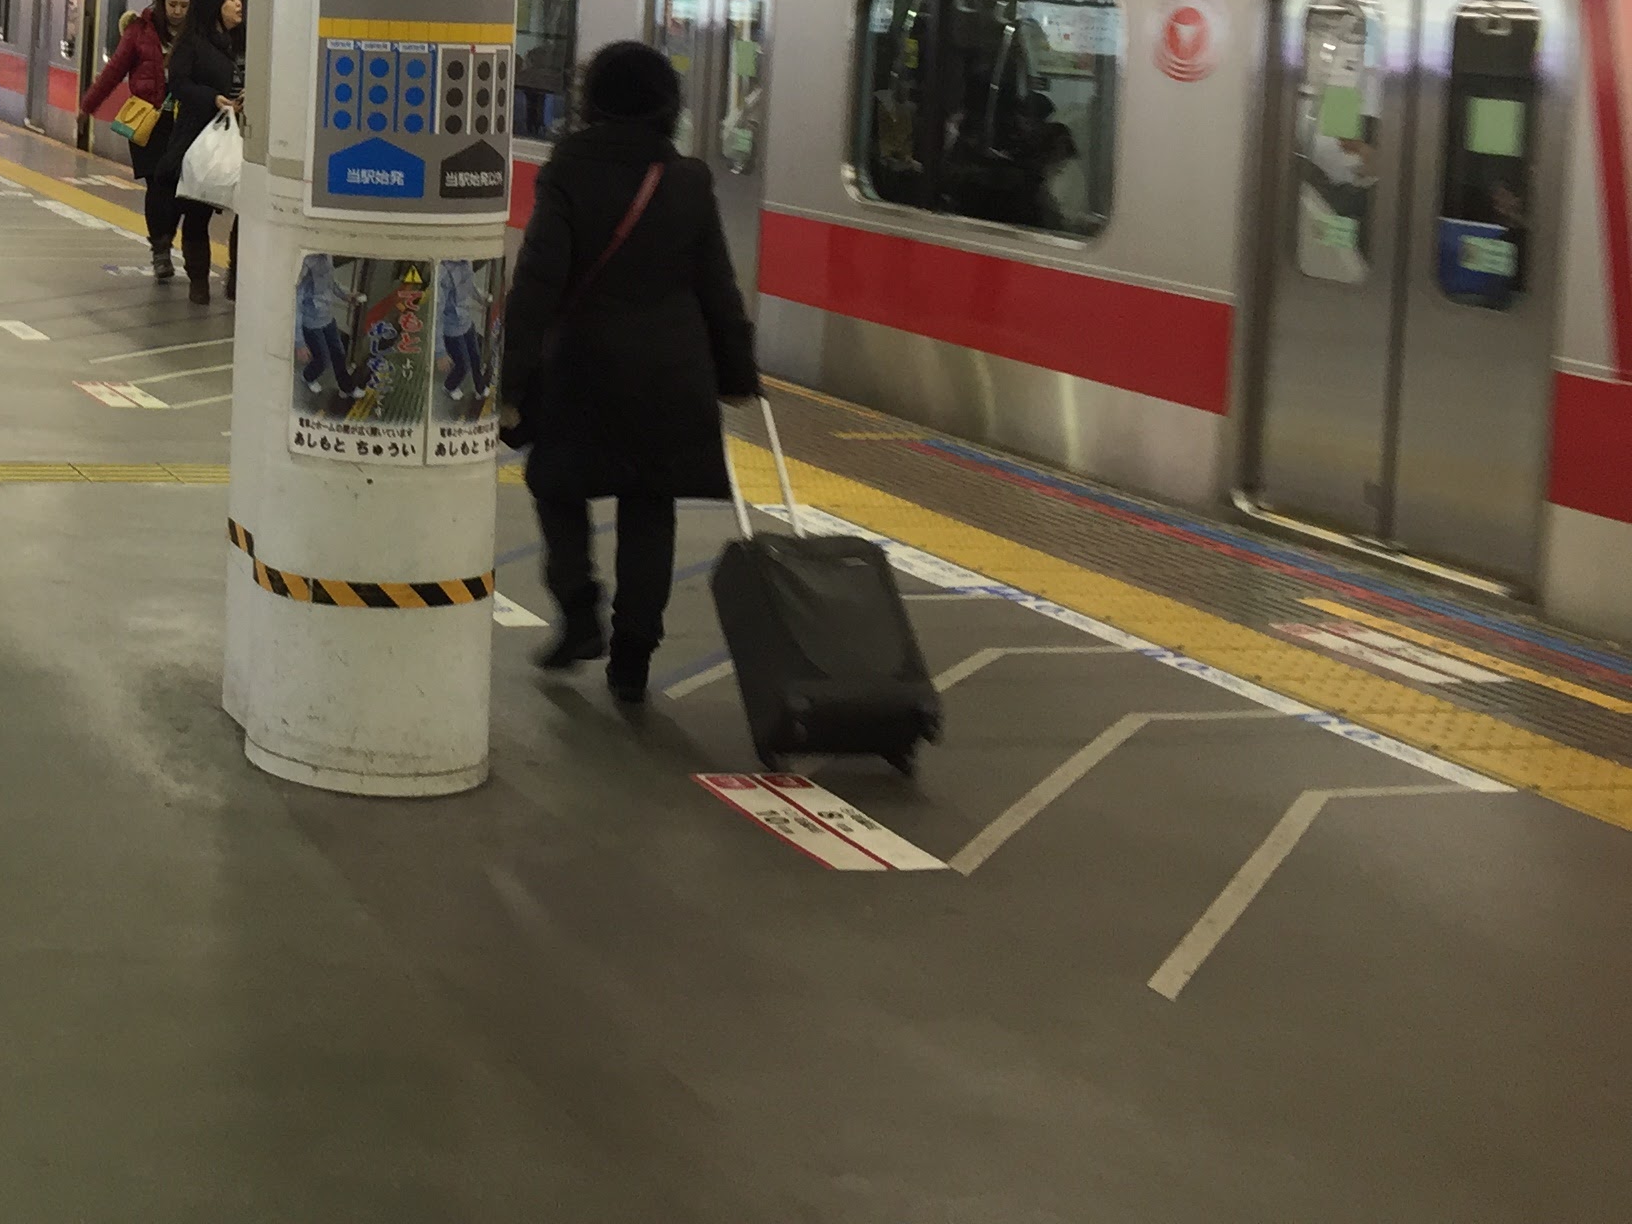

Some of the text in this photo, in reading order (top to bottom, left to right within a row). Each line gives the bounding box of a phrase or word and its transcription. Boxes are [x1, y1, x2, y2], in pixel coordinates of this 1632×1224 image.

[346, 167, 405, 187] 当駅始発
[294, 431, 417, 458] あしもと ちゅうい
[434, 440, 479, 458] あしもと
